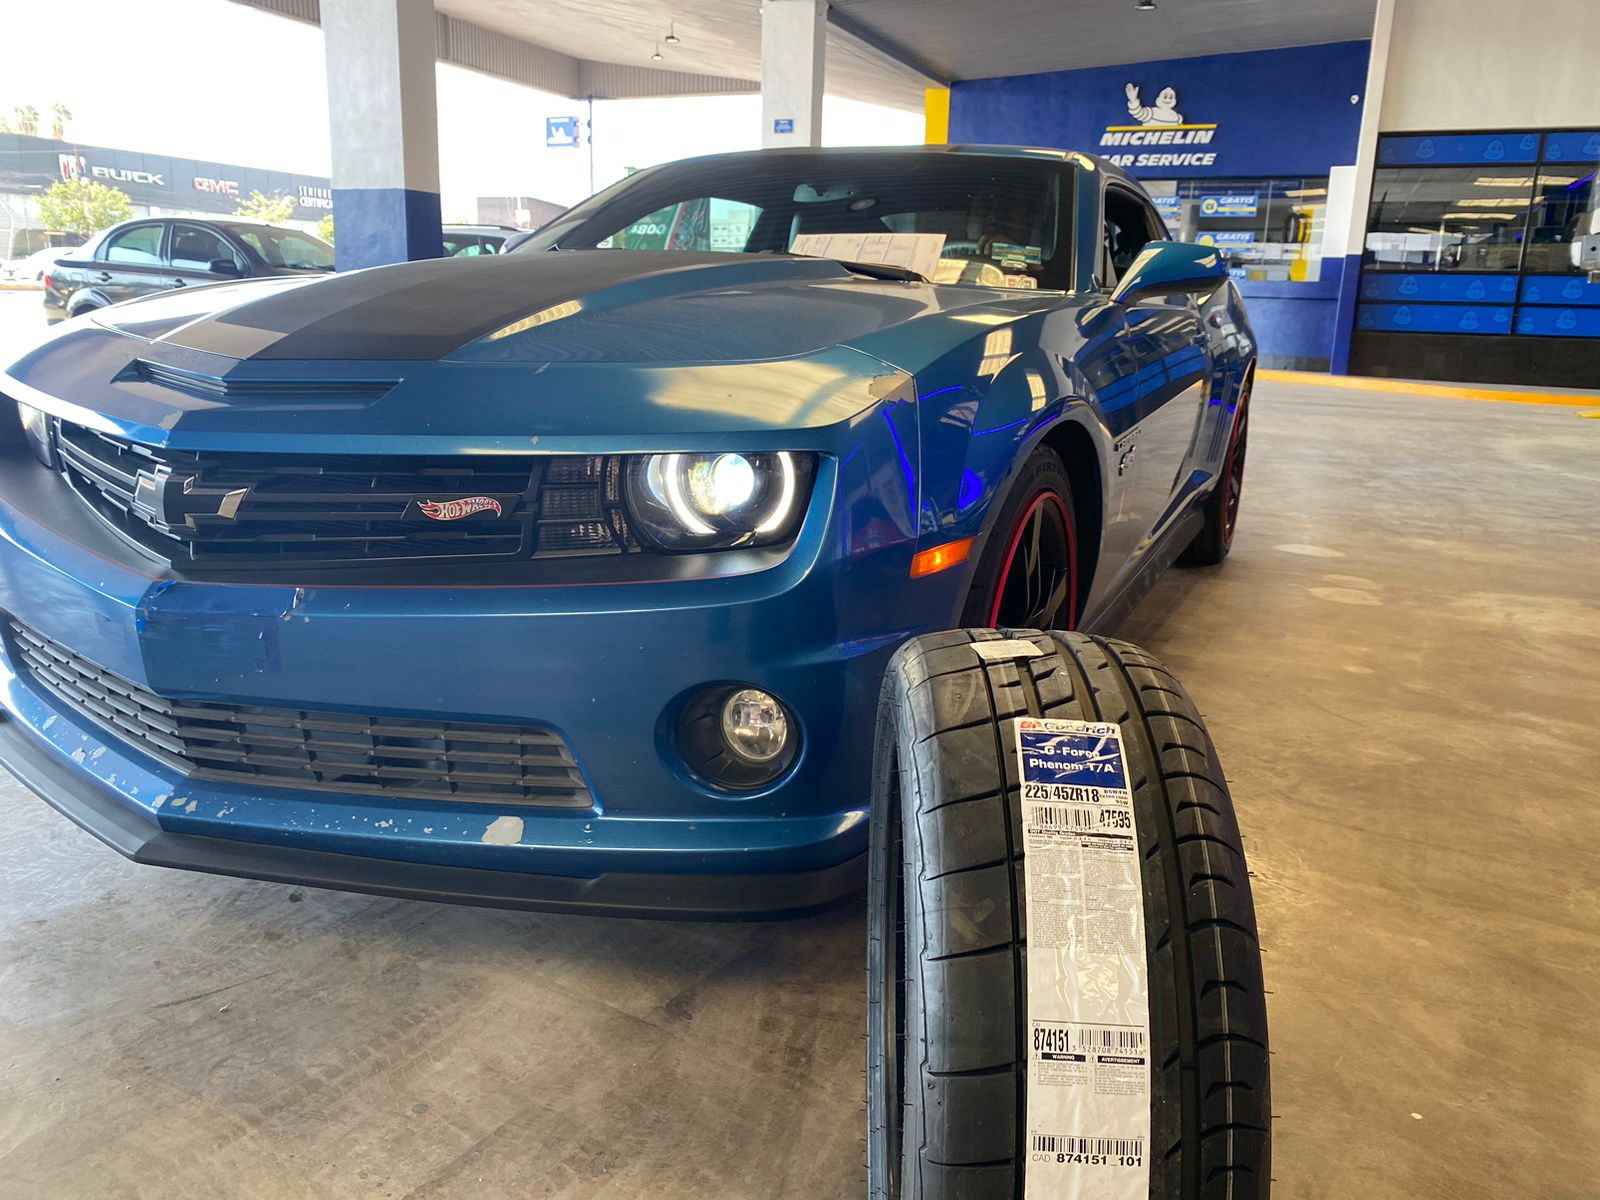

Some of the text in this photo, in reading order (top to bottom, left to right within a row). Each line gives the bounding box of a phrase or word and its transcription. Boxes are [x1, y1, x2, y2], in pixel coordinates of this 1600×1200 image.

[1099, 130, 1215, 146] MICHELIN
[1135, 153, 1217, 167] SERVICE
[91, 166, 165, 185] BUICK
[194, 177, 239, 195] GMC
[1219, 196, 1255, 204] GRATIS
[1215, 232, 1251, 240] GRATIS
[440, 499, 497, 518] HOT WHEELS
[1029, 758, 1115, 773] Phenom T/A
[1025, 784, 1100, 802] 225/45ZR18
[1099, 809, 1132, 829] 47595
[1033, 1027, 1069, 1053] 874151
[1101, 1056, 1141, 1064] AVERTISSEMENT
[1032, 1154, 1051, 1163] CAD
